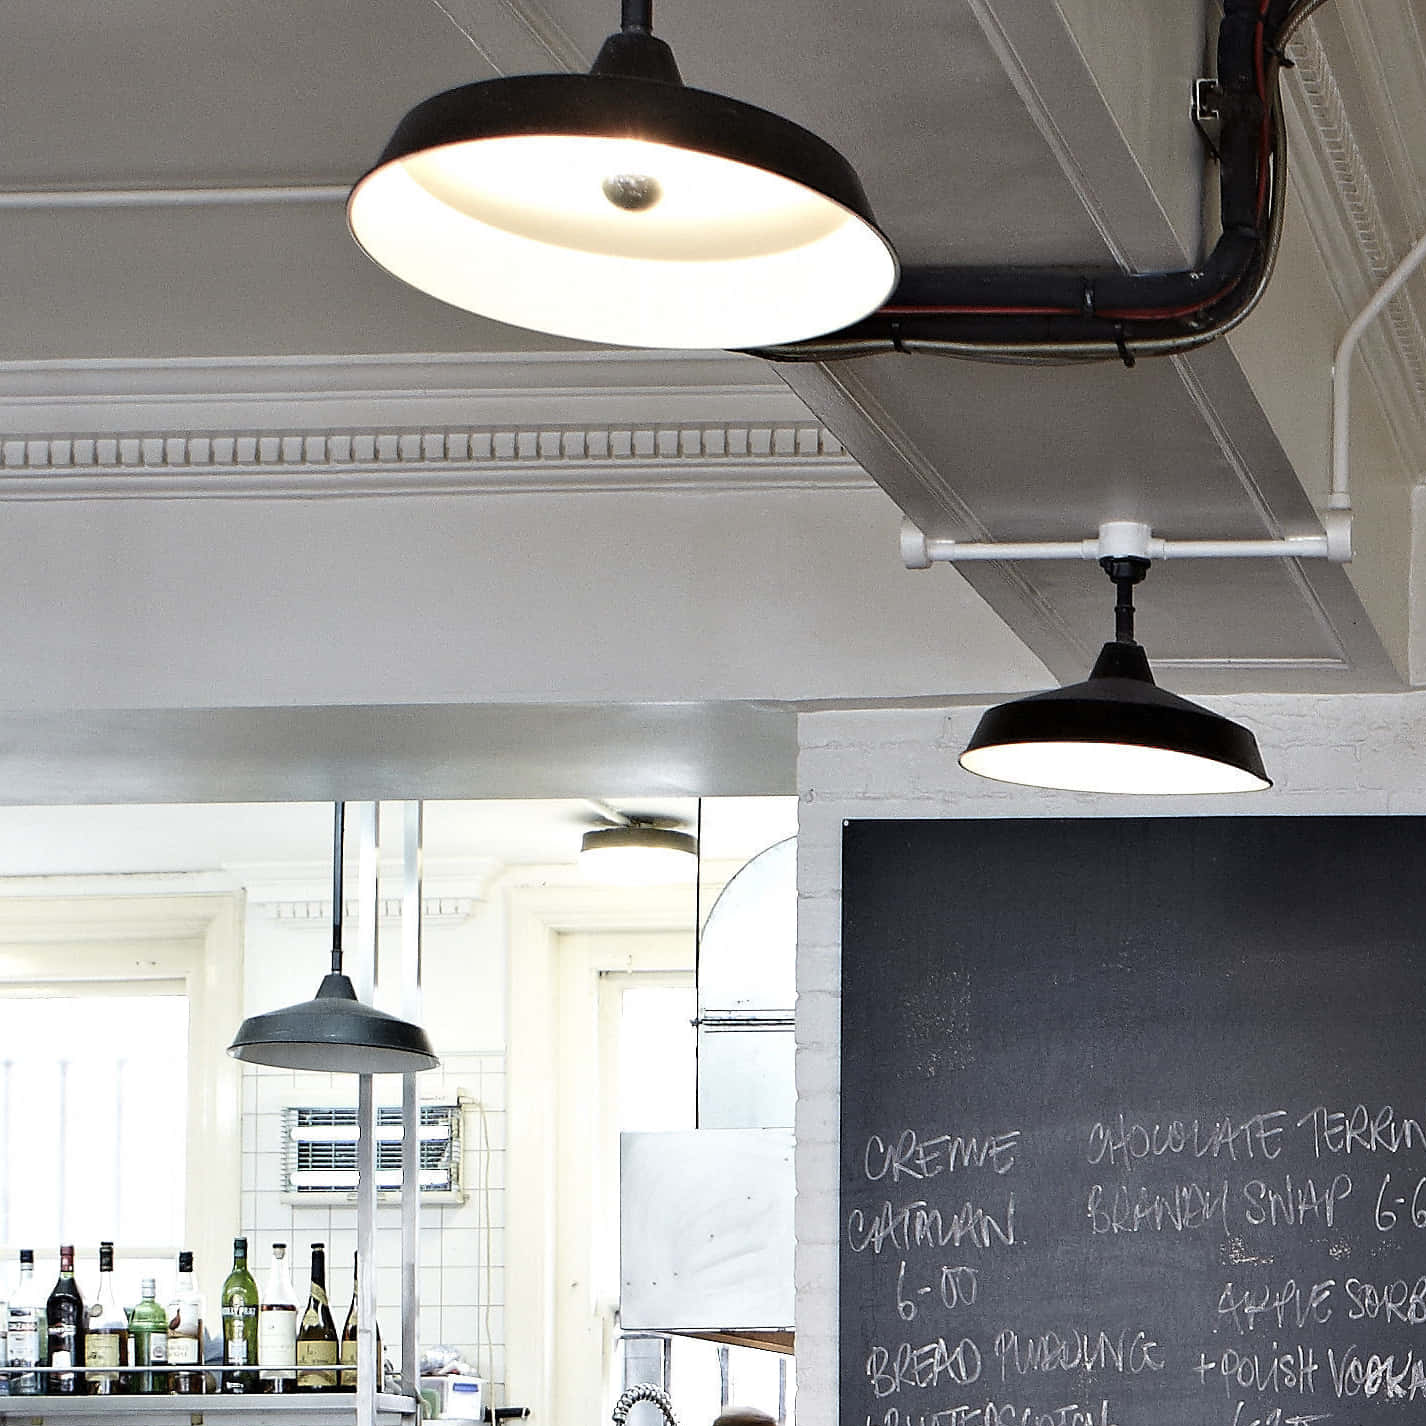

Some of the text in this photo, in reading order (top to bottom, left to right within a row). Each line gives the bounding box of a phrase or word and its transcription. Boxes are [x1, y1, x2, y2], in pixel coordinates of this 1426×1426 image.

[865, 1128, 1021, 1182] CREME
[1088, 1109, 1288, 1171] CHOCOLATE
[1087, 1179, 1231, 1236] BRANDY
[1244, 1174, 1352, 1228] SNAP
[1217, 1279, 1336, 1334] APPLE
[866, 1329, 1166, 1399] BREAD PUDDING
